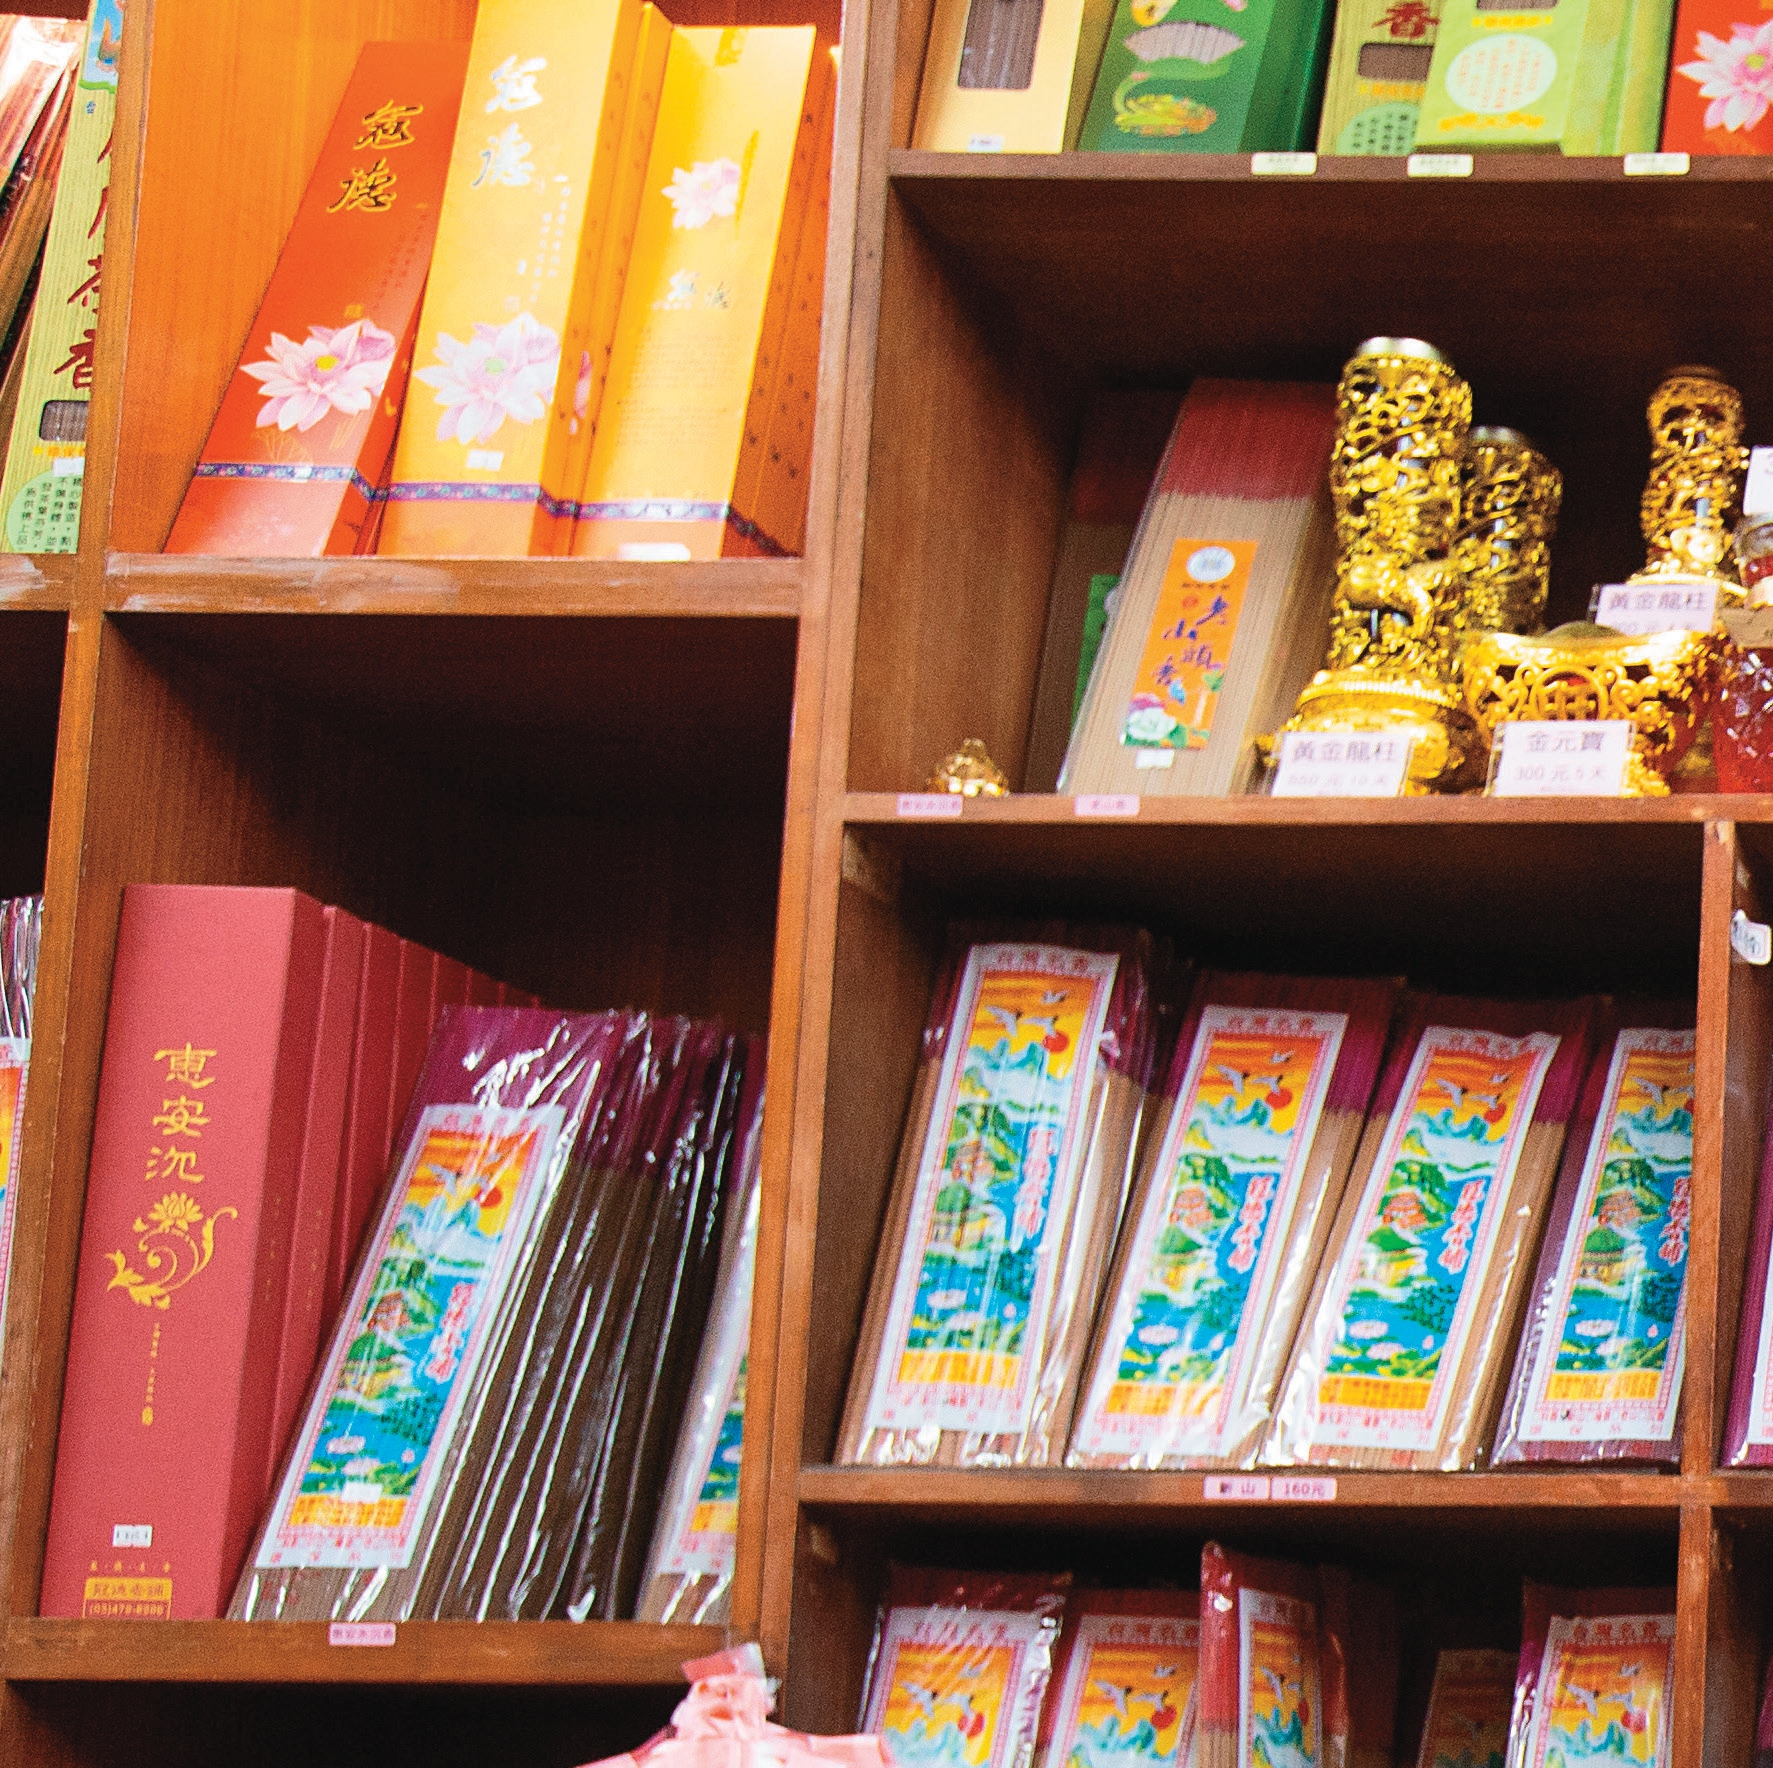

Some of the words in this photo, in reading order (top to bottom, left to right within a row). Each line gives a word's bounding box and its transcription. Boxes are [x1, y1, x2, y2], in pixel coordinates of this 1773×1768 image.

[1610, 592, 1708, 613] 黃金龍柱
[1291, 739, 1396, 764] 黃金龍柱
[1524, 730, 1602, 754] 金元寶
